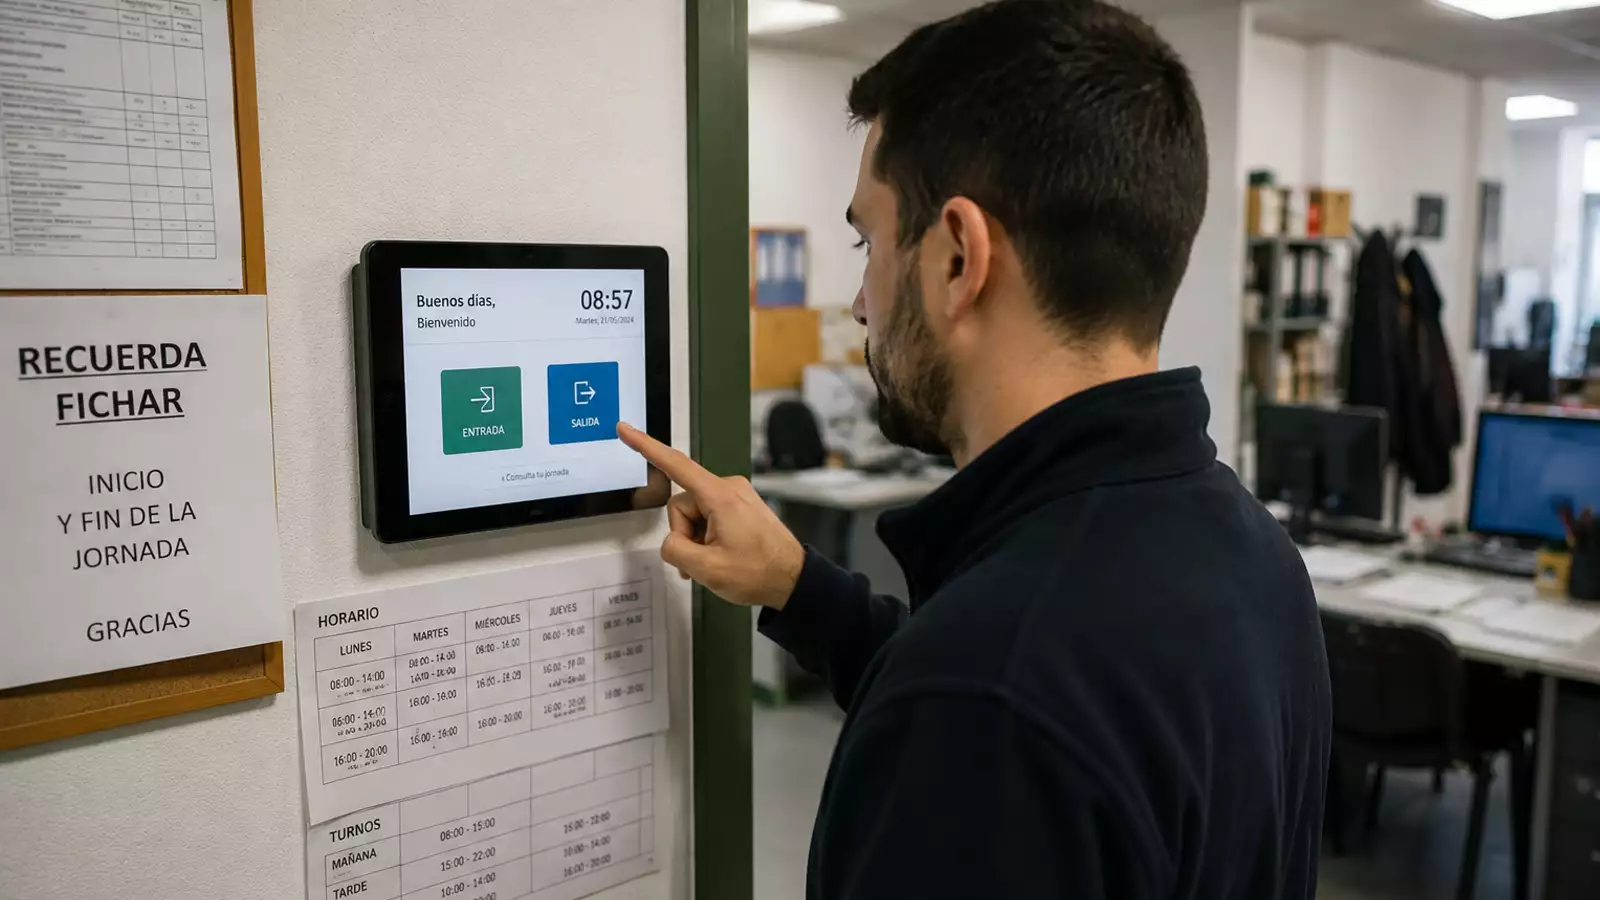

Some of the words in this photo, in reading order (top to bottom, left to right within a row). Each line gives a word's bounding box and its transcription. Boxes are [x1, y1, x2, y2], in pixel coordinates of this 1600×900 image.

[417, 295, 464, 308] Buenos
[581, 290, 633, 310] 08:57
[417, 316, 476, 329] Bienvenido
[18, 342, 207, 375] RECUERDA
[57, 387, 184, 420] FICHAR
[462, 425, 505, 438] ENTRADA
[571, 417, 600, 428] SALIDA
[89, 469, 165, 494] INICIO
[506, 471, 535, 481] Consulta
[536, 471, 544, 479] tu
[545, 468, 570, 480] jornada
[57, 514, 73, 534] Y
[82, 509, 120, 532] FIN
[130, 504, 160, 527] DE
[169, 501, 197, 522] LA
[73, 538, 190, 570] JORNADA
[318, 607, 379, 628] HORARIO
[549, 602, 577, 616] JUEVES
[87, 609, 190, 642] GRACIAS
[475, 613, 521, 630] MIÉRCOLES
[413, 627, 449, 642] MARTES
[340, 641, 372, 656] LUNES
[334, 752, 358, 766] 16:00
[364, 745, 388, 759] 20:00
[329, 818, 381, 843] TURNOS
[472, 817, 496, 832] 15:00
[332, 848, 377, 870] MAÑANA
[441, 856, 464, 872] 15:00
[472, 846, 496, 862] 22:00
[333, 880, 368, 900] TARDE
[441, 882, 465, 898] 10:00
